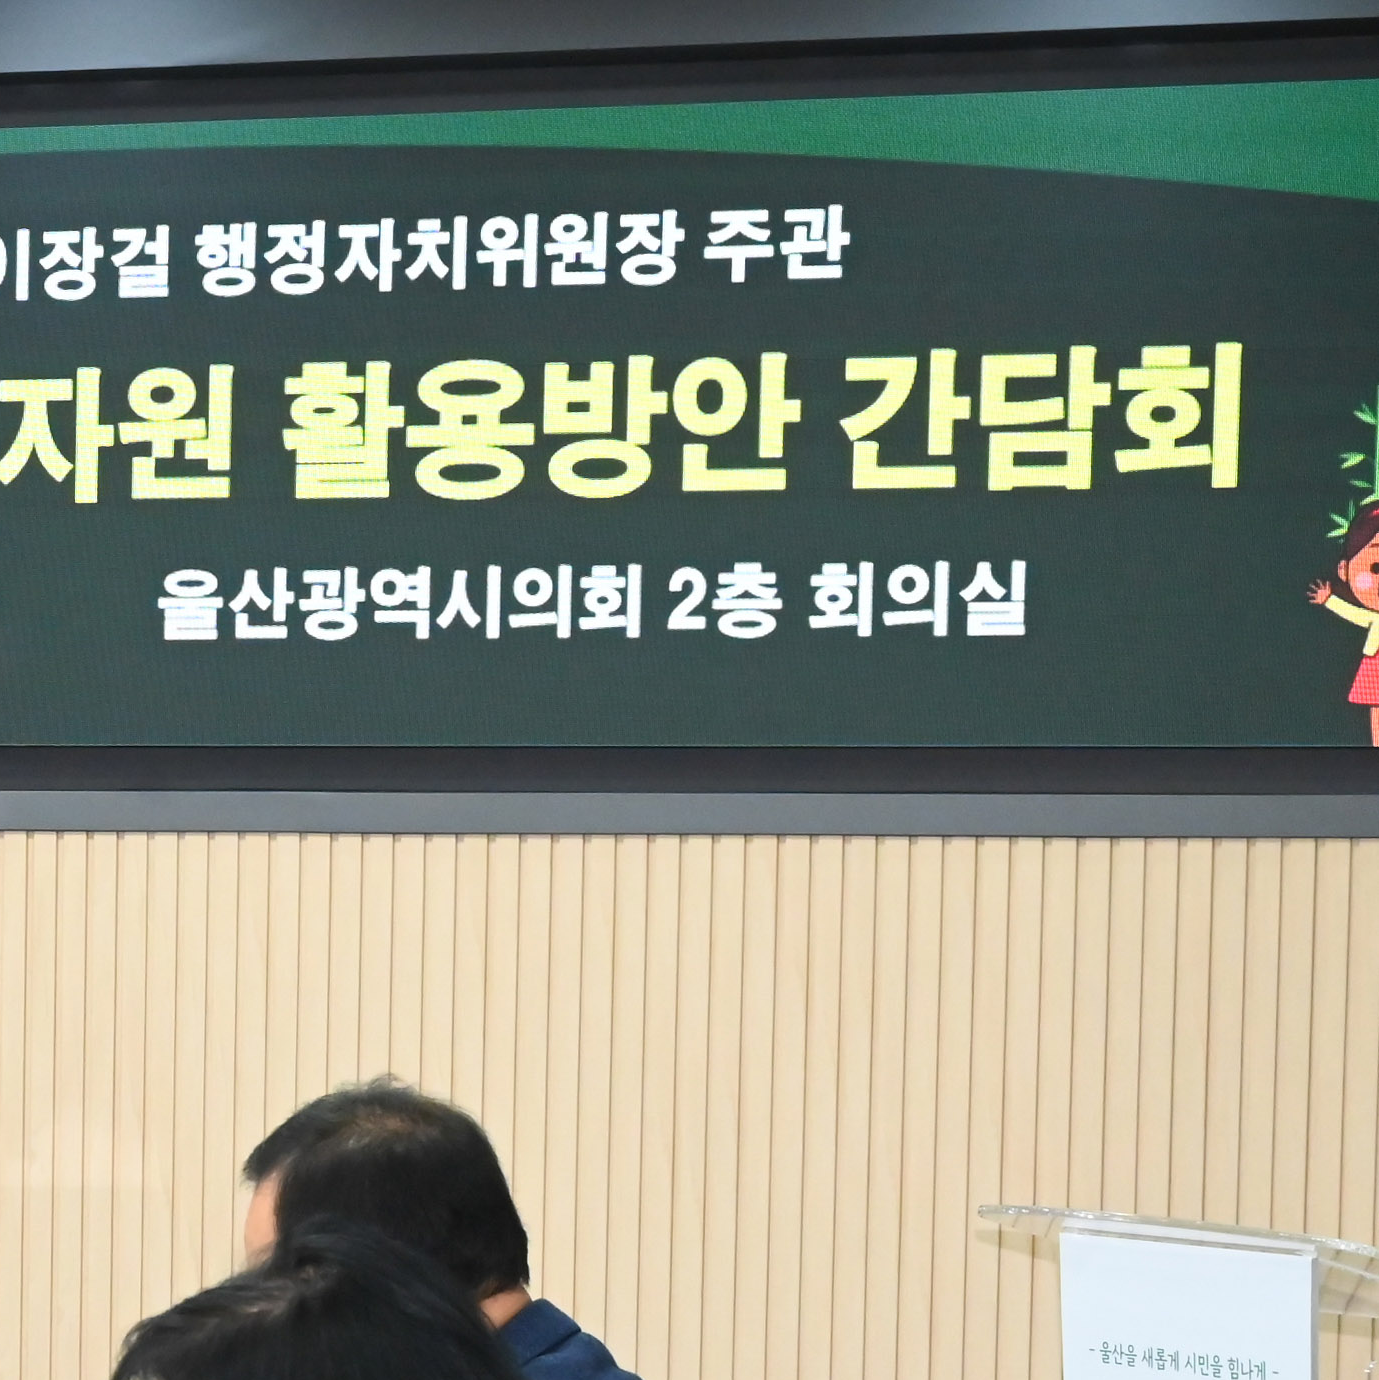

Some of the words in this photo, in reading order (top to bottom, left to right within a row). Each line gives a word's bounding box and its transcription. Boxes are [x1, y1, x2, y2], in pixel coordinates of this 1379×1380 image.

[194, 209, 686, 298] 행정자치위원장
[703, 203, 852, 283] 주관
[282, 351, 802, 501] 활용방안
[838, 341, 1243, 492] 간담회
[157, 562, 643, 642] 울산광역시의회
[666, 561, 784, 640] 2층
[808, 559, 1028, 638] 회의실
[1099, 1341, 1138, 1367] 울산을
[1141, 1347, 1180, 1371] 새롭게
[1184, 1352, 1223, 1378] 시민을
